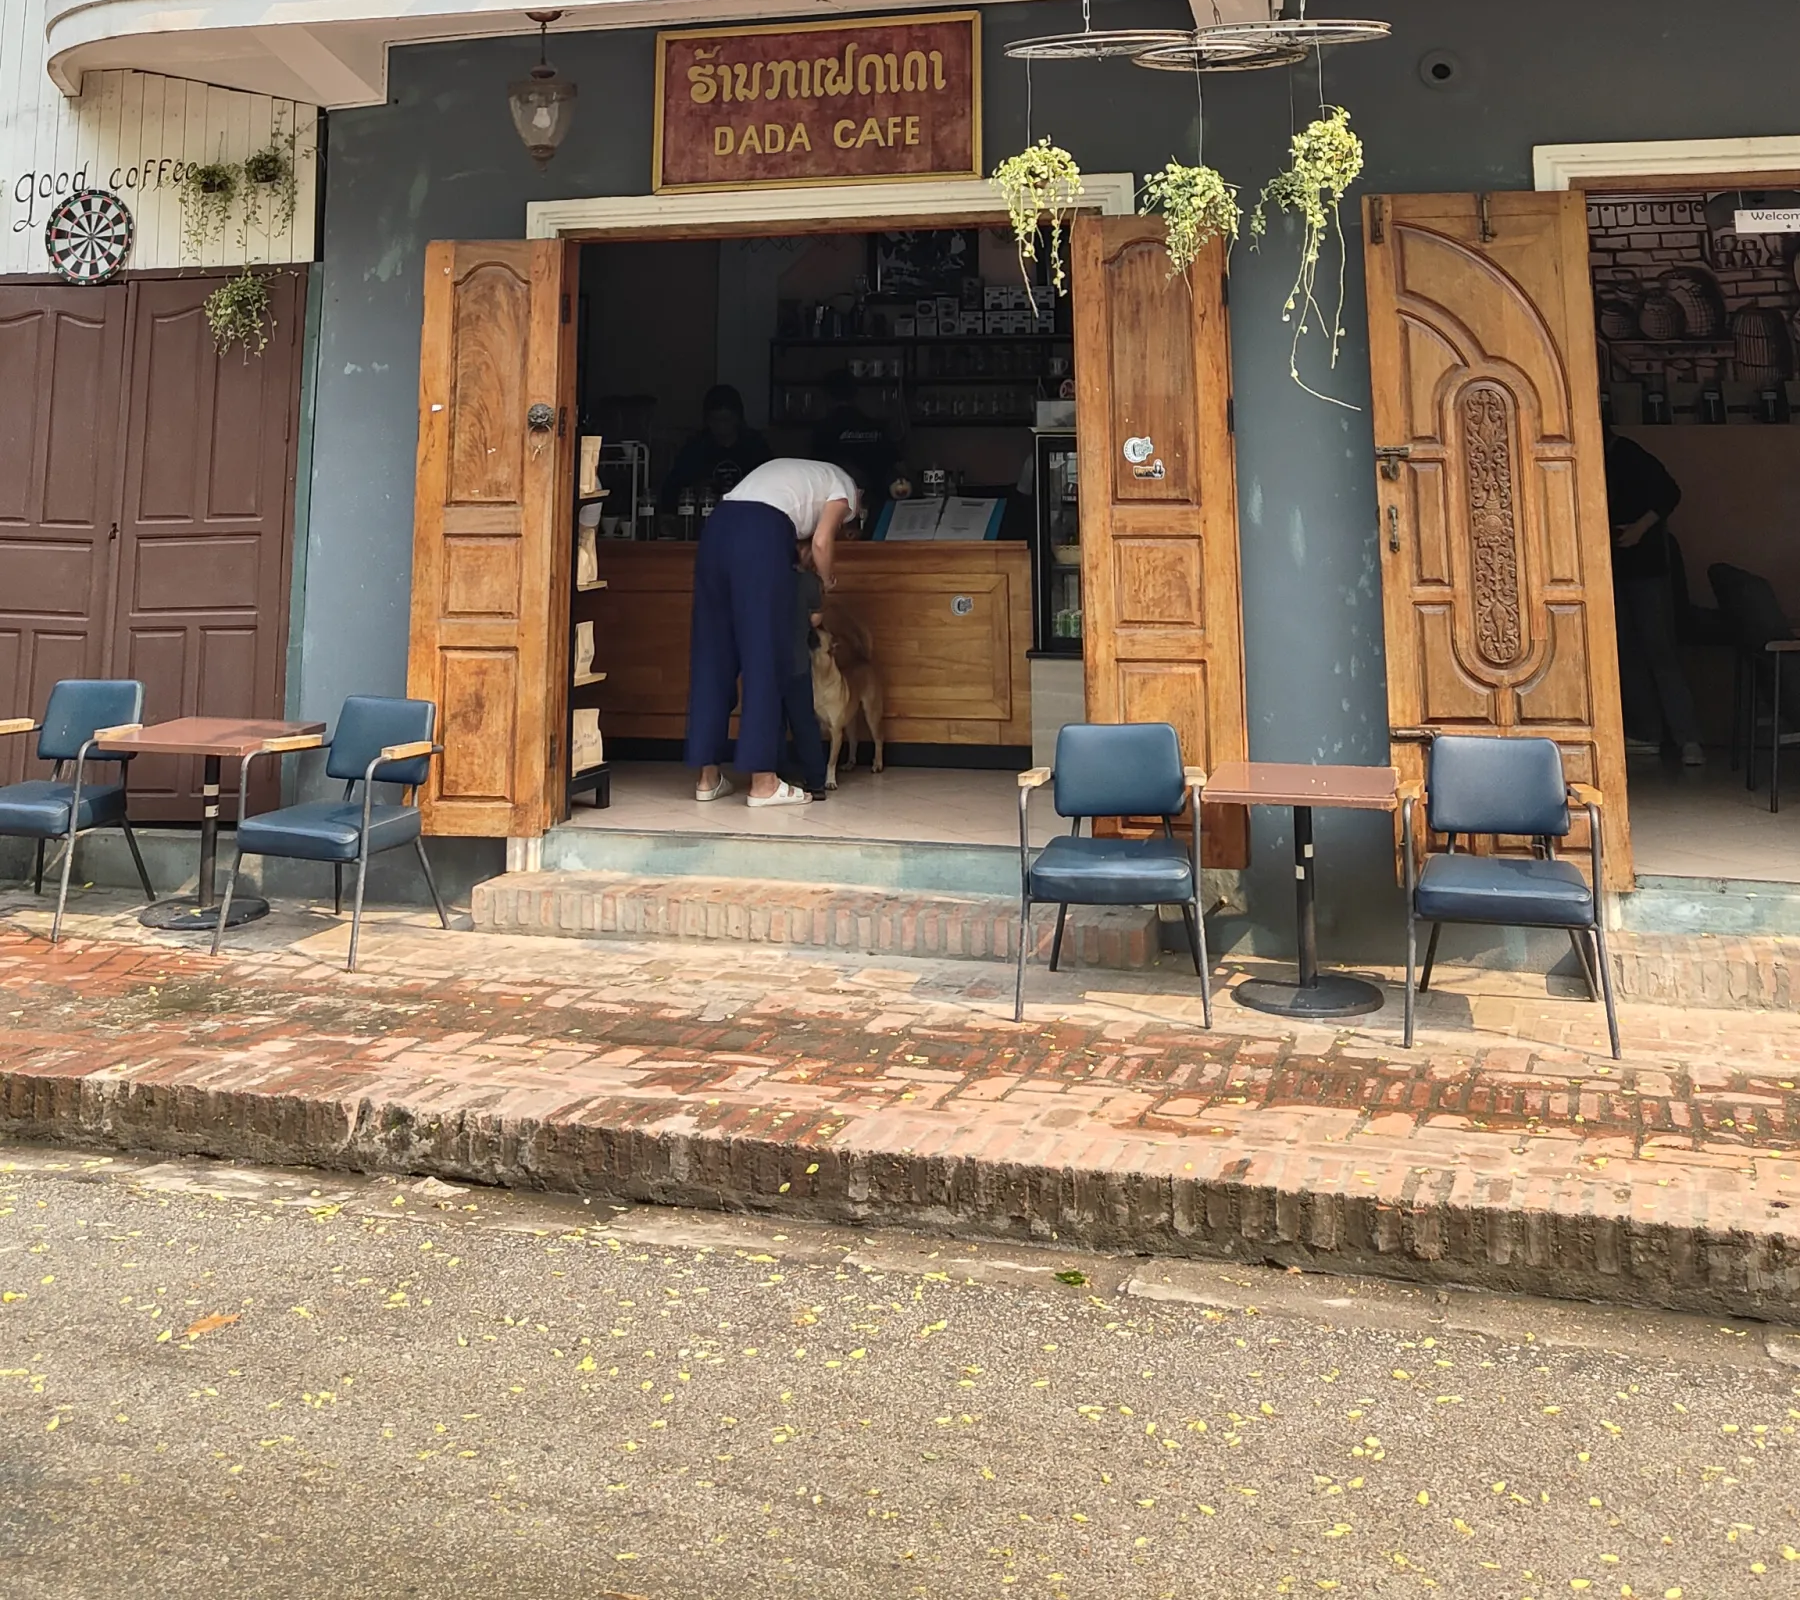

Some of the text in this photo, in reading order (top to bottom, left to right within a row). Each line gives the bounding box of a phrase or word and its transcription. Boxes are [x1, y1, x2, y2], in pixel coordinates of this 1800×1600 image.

[714, 115, 920, 156] DADA CAFE
[13, 160, 91, 233] good
